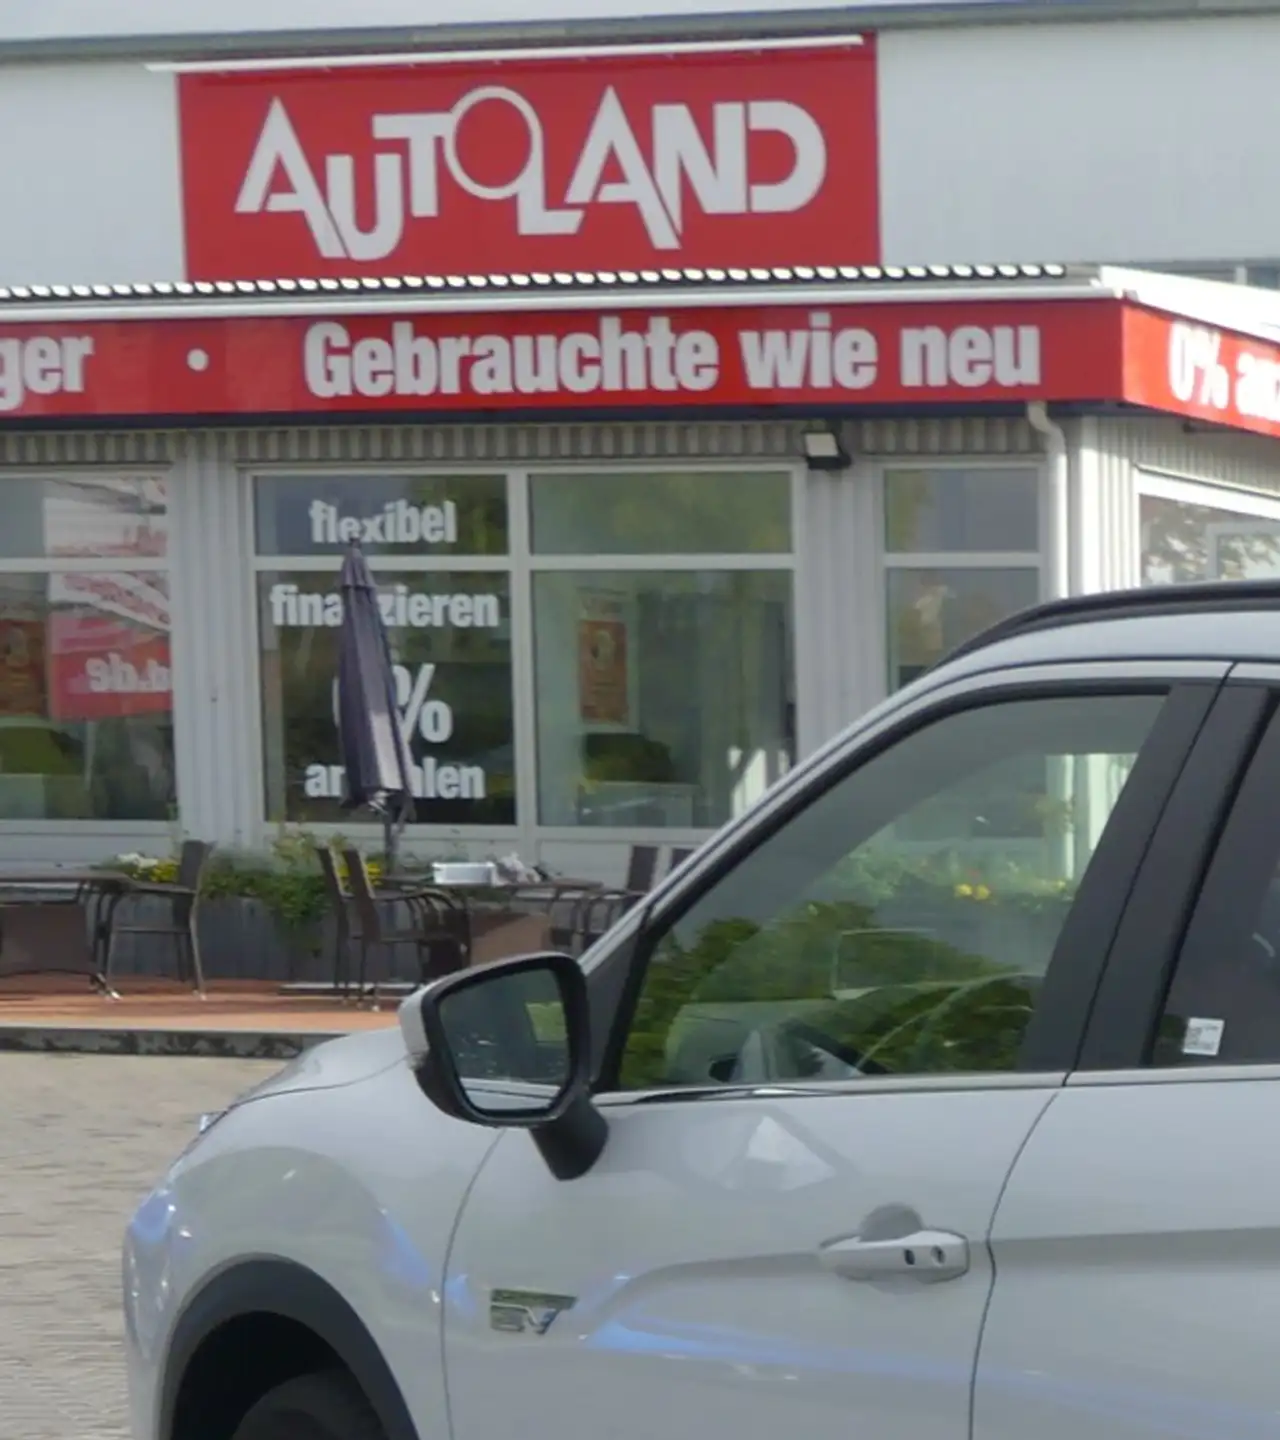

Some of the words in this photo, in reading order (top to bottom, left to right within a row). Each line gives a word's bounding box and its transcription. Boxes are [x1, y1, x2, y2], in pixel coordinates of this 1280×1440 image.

[234, 85, 827, 261] AUTOLAND
[304, 316, 719, 398] Gebrauchte
[738, 311, 878, 389] wie
[900, 326, 1041, 387] neu
[1168, 320, 1229, 409] 0%
[310, 500, 457, 543] flexibel
[270, 584, 499, 627] finazieren
